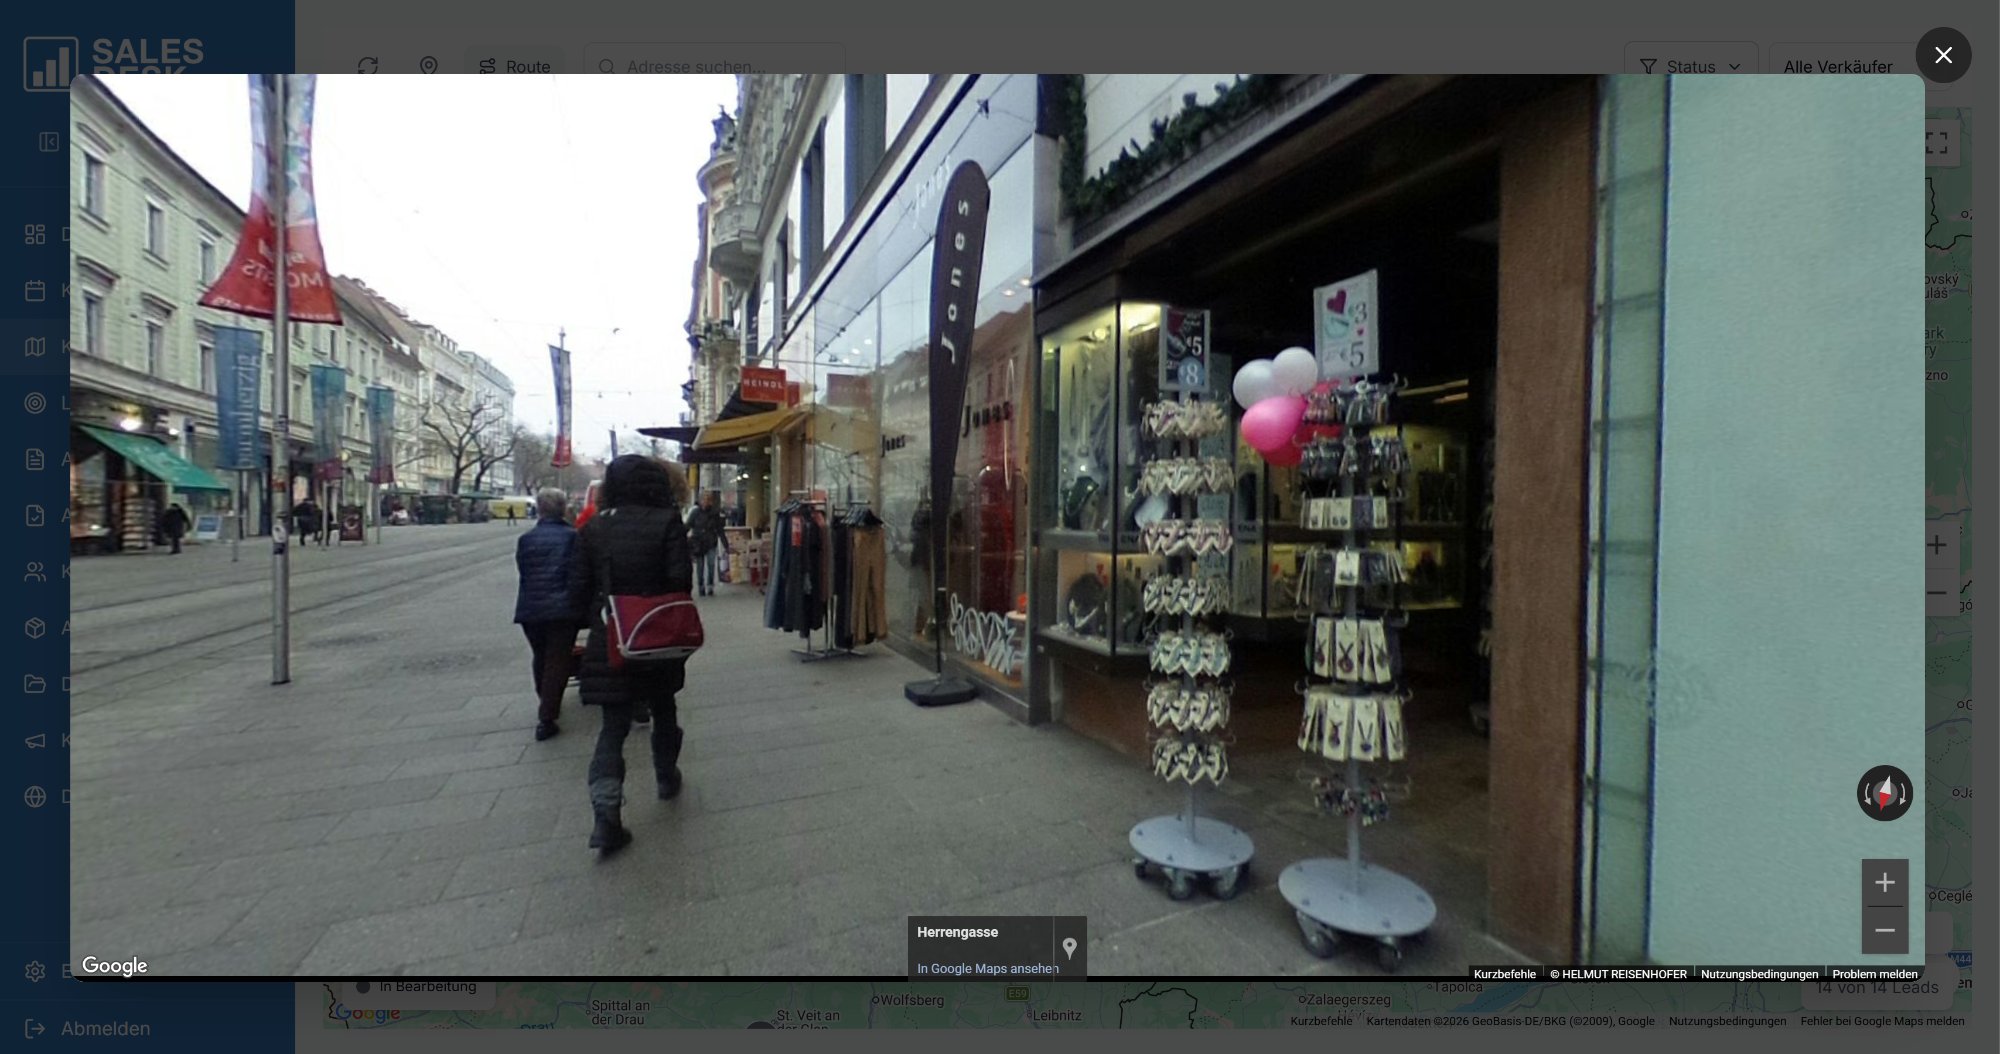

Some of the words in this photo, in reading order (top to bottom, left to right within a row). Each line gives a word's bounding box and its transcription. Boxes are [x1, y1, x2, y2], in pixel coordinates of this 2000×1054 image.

[93, 39, 204, 64] SALES
[507, 60, 551, 73] Route
[627, 59, 690, 74] Adresse
[696, 59, 767, 74] suchen...
[1668, 60, 1716, 74] Status
[1784, 60, 1813, 73] Alle
[1817, 59, 1893, 73] Verkäufer
[940, 199, 970, 364] Jones
[381, 982, 392, 992] In
[397, 982, 477, 995] Bearbeitung
[1008, 989, 1027, 998] E59
[1434, 982, 1483, 995] Tapolca
[1816, 982, 1833, 993] 14
[1837, 983, 1865, 994] von
[1870, 982, 1887, 993] 14
[1893, 982, 1939, 994] Leads
[591, 1000, 630, 1013] Spittal
[634, 1002, 650, 1011] an
[881, 994, 944, 1008] Wolfsberg
[1307, 994, 1391, 1008] Zalaegerszeg
[335, 1003, 401, 1024] Google
[591, 1014, 613, 1025] der
[616, 1014, 645, 1026] Drau
[777, 1009, 794, 1021] St.
[797, 1009, 820, 1021] Veit
[824, 1012, 840, 1021] an
[1033, 1009, 1082, 1022] Leibnitz
[1290, 1015, 1353, 1026] Kurzbefehle
[61, 1020, 151, 1036] Abmelden
[1367, 1015, 1431, 1026] Kartendaten
[1434, 1015, 1470, 1026] ©2026
[1472, 1015, 1567, 1027] GeoBasis-DE/BKG
[1569, 1015, 1616, 1029] (©2009),
[1618, 1015, 1656, 1028] Google
[1669, 1015, 1787, 1029] Nutzungsbedingungen
[1801, 1015, 1833, 1026] Fehler
[1836, 1015, 1850, 1026] bei
[1854, 1015, 1892, 1029] Google
[1895, 1015, 1924, 1029] Maps
[1926, 1015, 1965, 1026] melden
